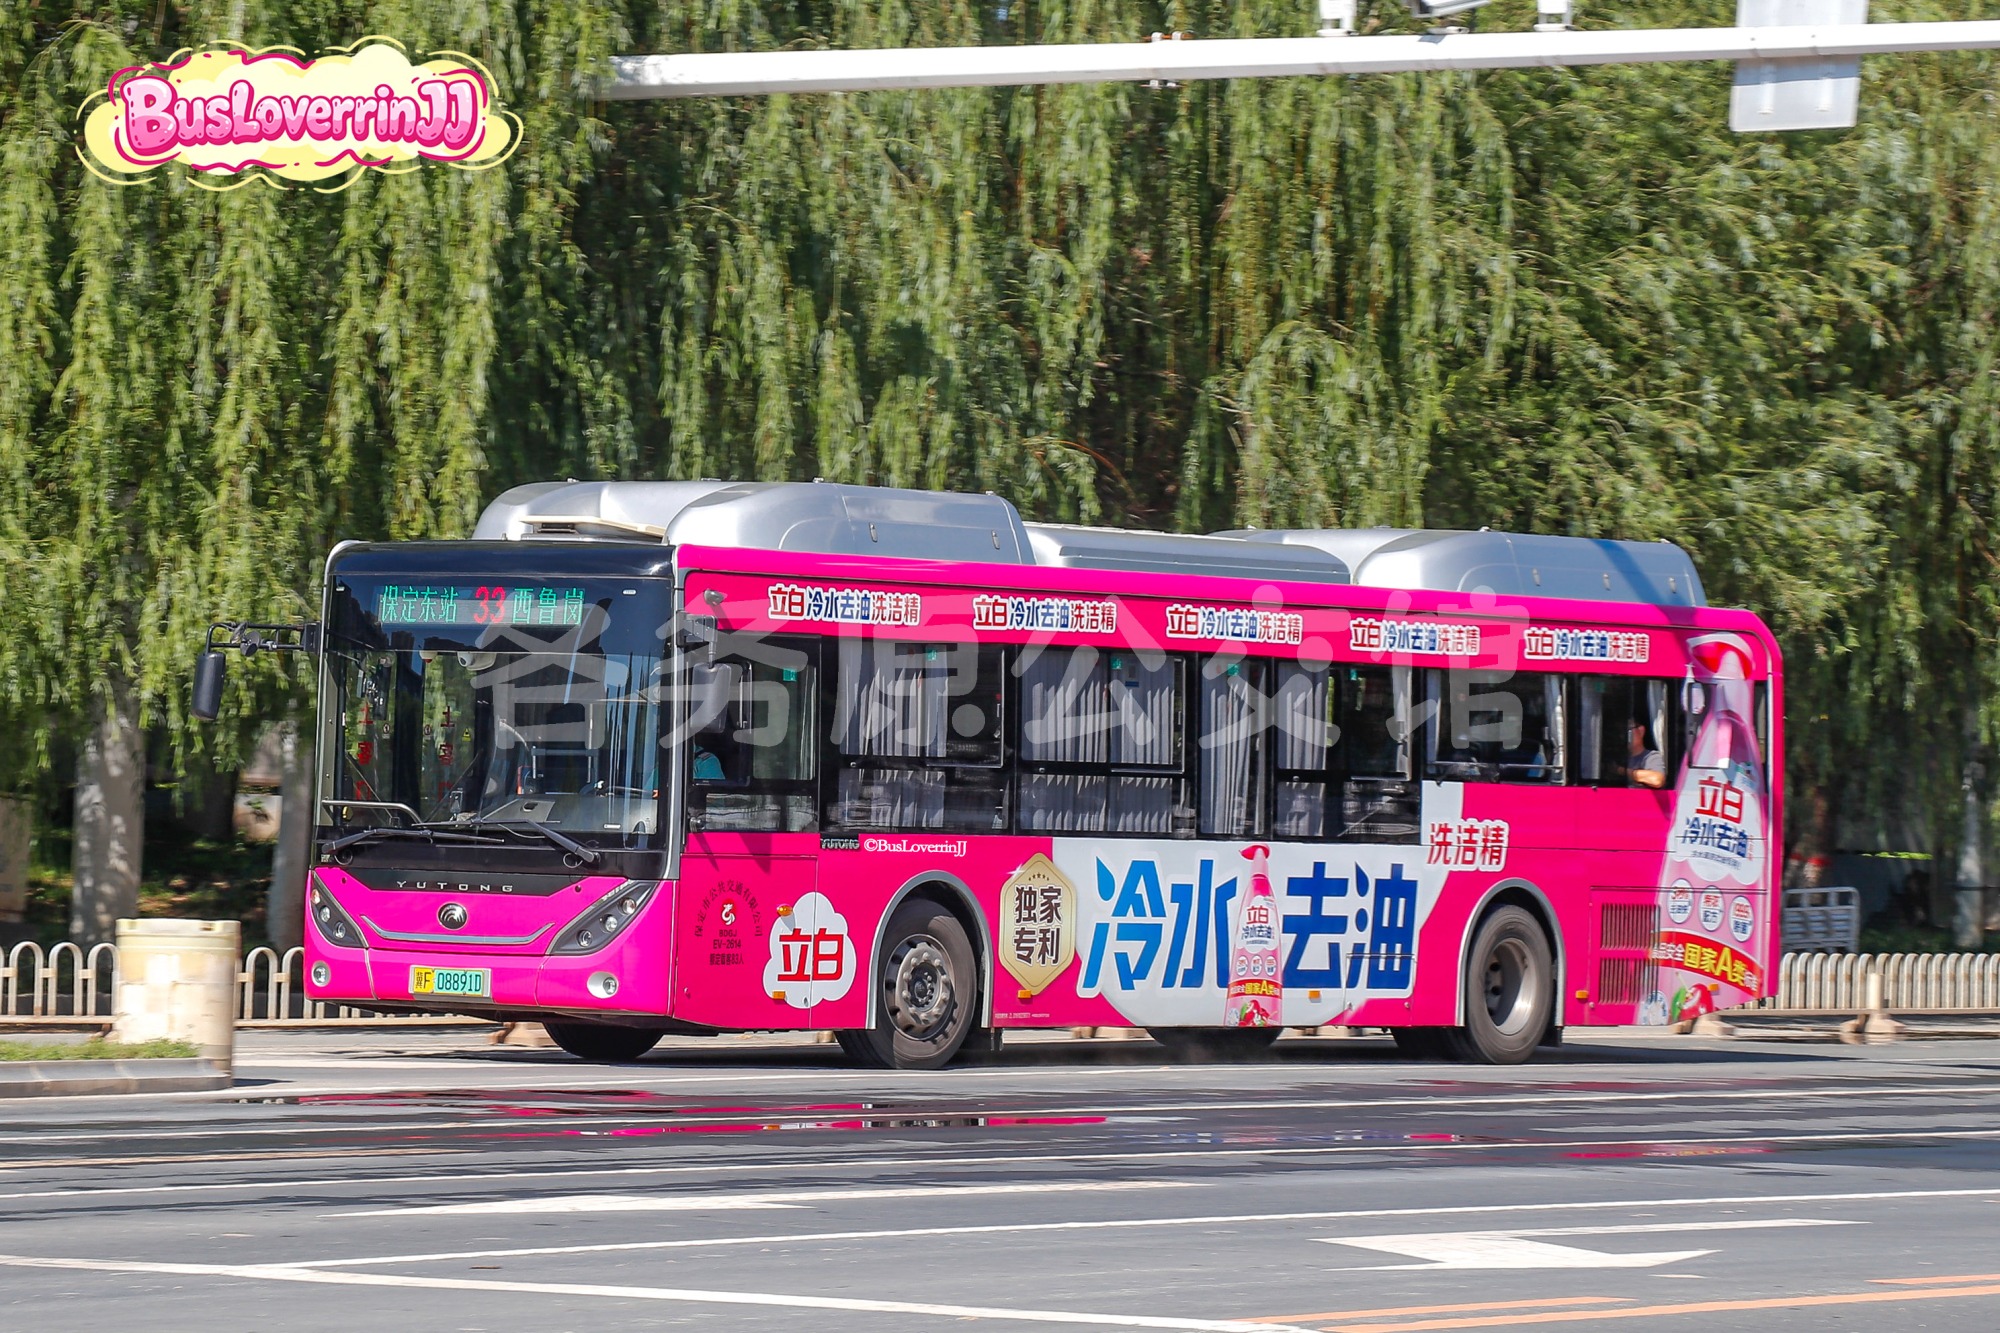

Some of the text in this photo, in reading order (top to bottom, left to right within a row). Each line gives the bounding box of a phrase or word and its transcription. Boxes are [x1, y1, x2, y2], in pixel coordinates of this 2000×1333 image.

[380, 585, 584, 625] 保定东站 33 西鲁岗
[769, 585, 920, 625] 立白冷水去油洗洁精
[974, 595, 1117, 633] 立白冷水去油洗洁精
[1167, 604, 1302, 644] 立白冷水去油洗洁精
[1350, 618, 1480, 656] 立白冷水去油洗洁精
[1526, 627, 1649, 662] 立白冷水去油洗洁精
[1695, 776, 1744, 824] 立白
[821, 838, 859, 850] YUTONG
[1427, 821, 1507, 867] 洗洁精
[1682, 817, 1747, 857] 冷水去油
[397, 880, 513, 893] YUTONG
[1015, 885, 1062, 924] 独家
[1083, 856, 1418, 990] 冷水 去油
[1247, 905, 1269, 924] 立白
[713, 939, 741, 949] EV-2614
[777, 926, 844, 981] 立白
[1014, 926, 1060, 965] 专利
[437, 972, 482, 991] 08891D
